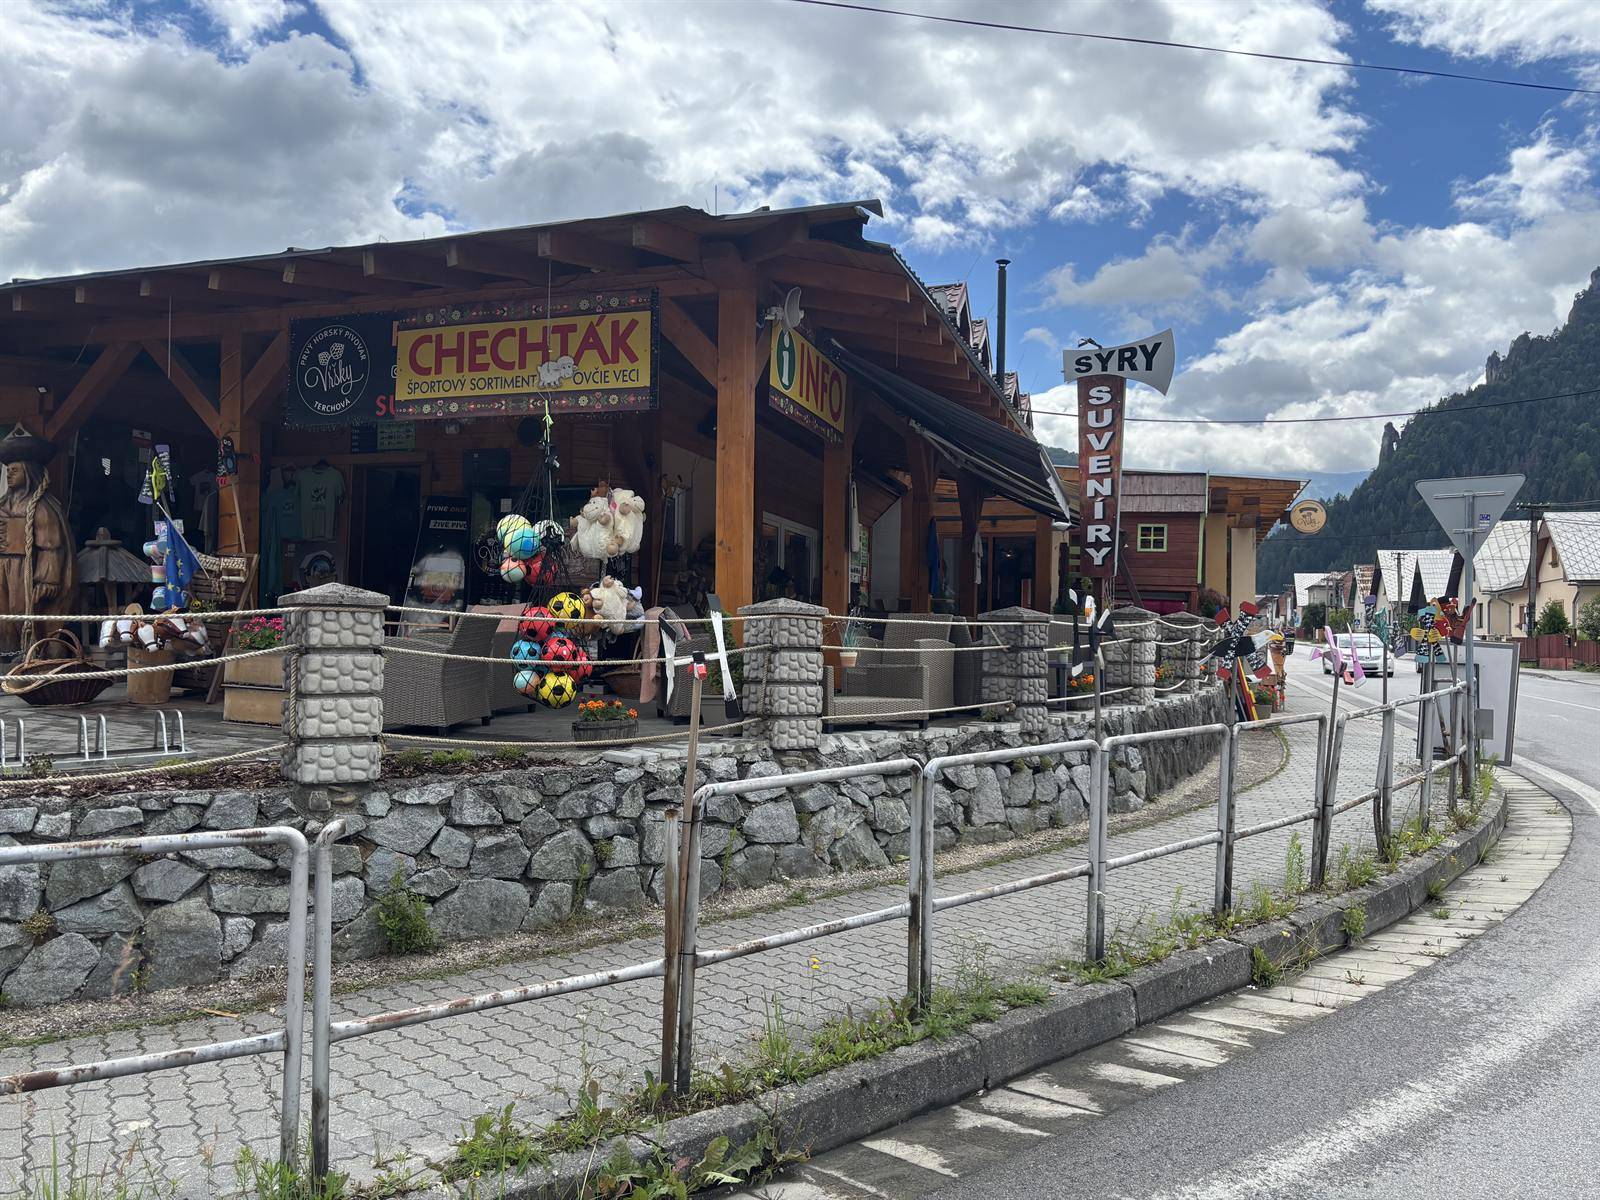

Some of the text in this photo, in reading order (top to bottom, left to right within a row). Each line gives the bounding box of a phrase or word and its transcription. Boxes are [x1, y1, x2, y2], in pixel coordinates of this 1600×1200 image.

[344, 330, 367, 361] PIVOVAR
[408, 315, 640, 376] CHECHTÁK
[1074, 341, 1162, 373] SYRY
[407, 368, 640, 395] ŠPORTOVÝ SORTIMENT OVČIE VECI
[799, 342, 843, 423] INFO
[1085, 386, 1115, 566] SUVENÍRY
